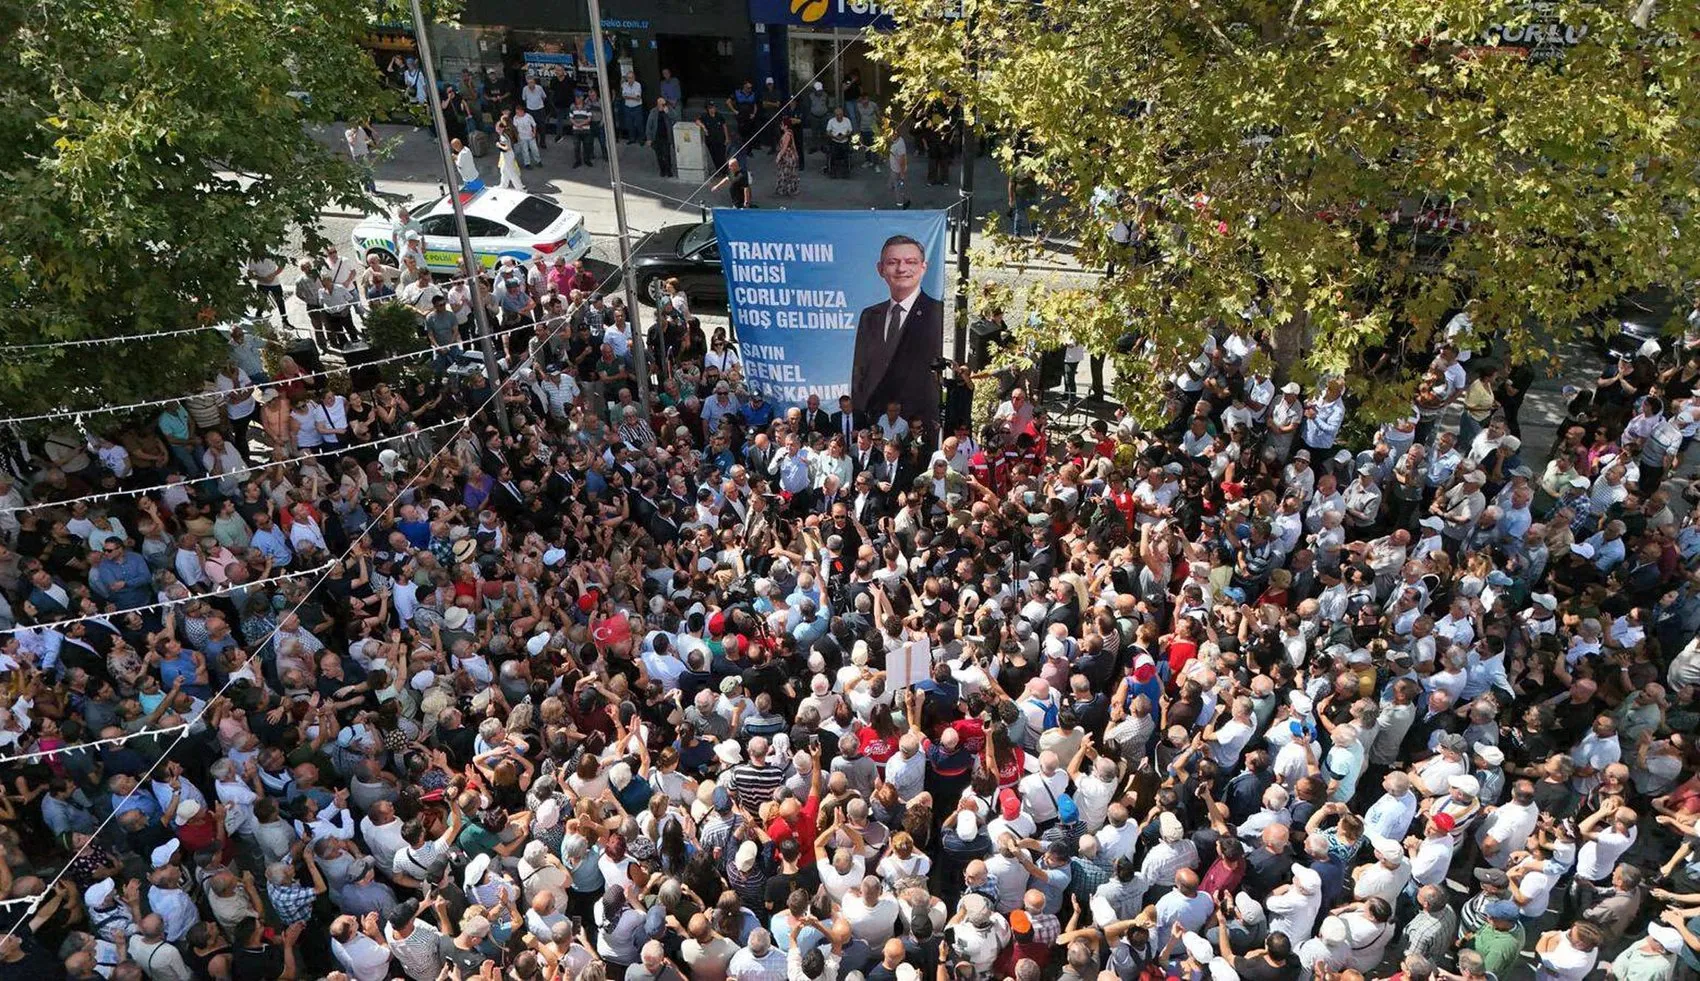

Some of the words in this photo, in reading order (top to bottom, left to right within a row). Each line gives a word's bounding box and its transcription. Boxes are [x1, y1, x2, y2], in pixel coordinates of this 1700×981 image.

[728, 241, 834, 263] TRAKYA'NIN
[732, 263, 786, 284] İNCİSİ
[738, 308, 772, 330] HOŞ
[776, 310, 856, 330] GELDİNİZ
[742, 342, 785, 361] SAYIN
[745, 360, 806, 383] GENEL
